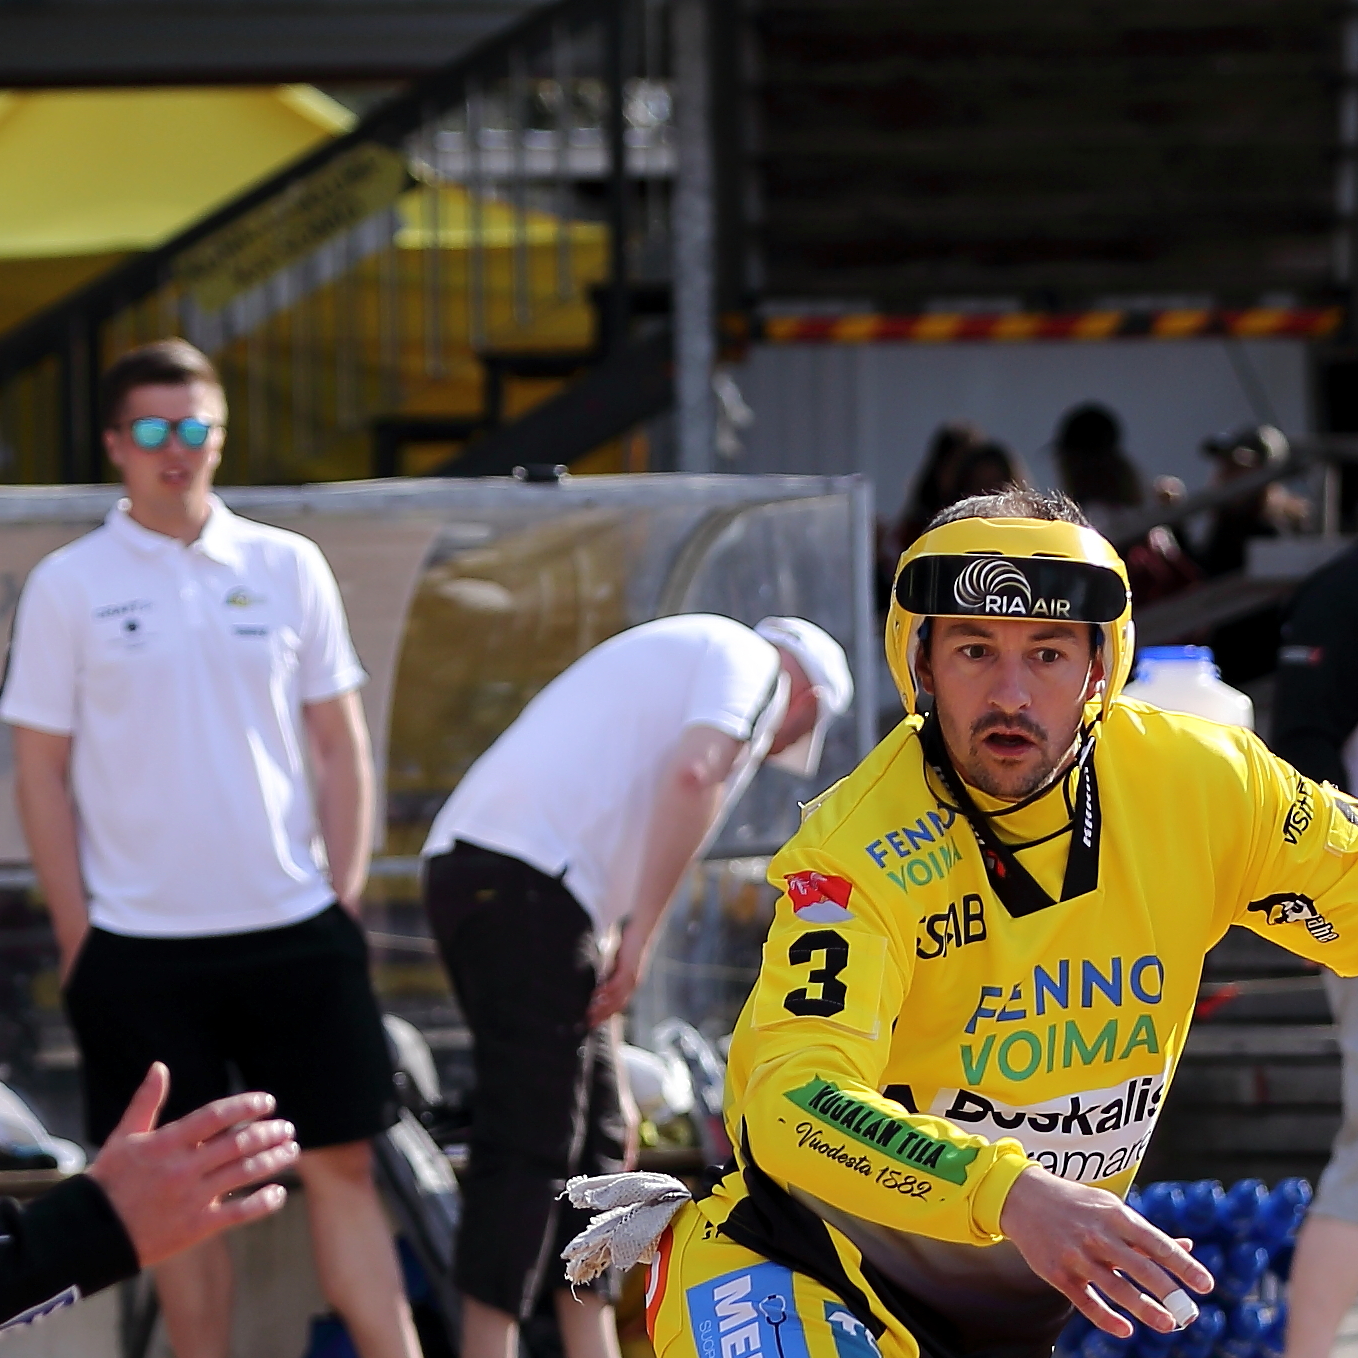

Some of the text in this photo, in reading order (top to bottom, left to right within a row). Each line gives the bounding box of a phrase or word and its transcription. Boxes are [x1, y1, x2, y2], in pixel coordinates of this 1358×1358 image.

[984, 594, 1071, 618] RIA AIR
[915, 892, 988, 960] SAB
[783, 929, 850, 1019] 3
[963, 954, 1165, 1035] FENNO
[959, 1014, 1160, 1087] VOIMA
[795, 1121, 933, 1203] Vuodesta 1582
[807, 1084, 948, 1170] KUJALAN TILA
